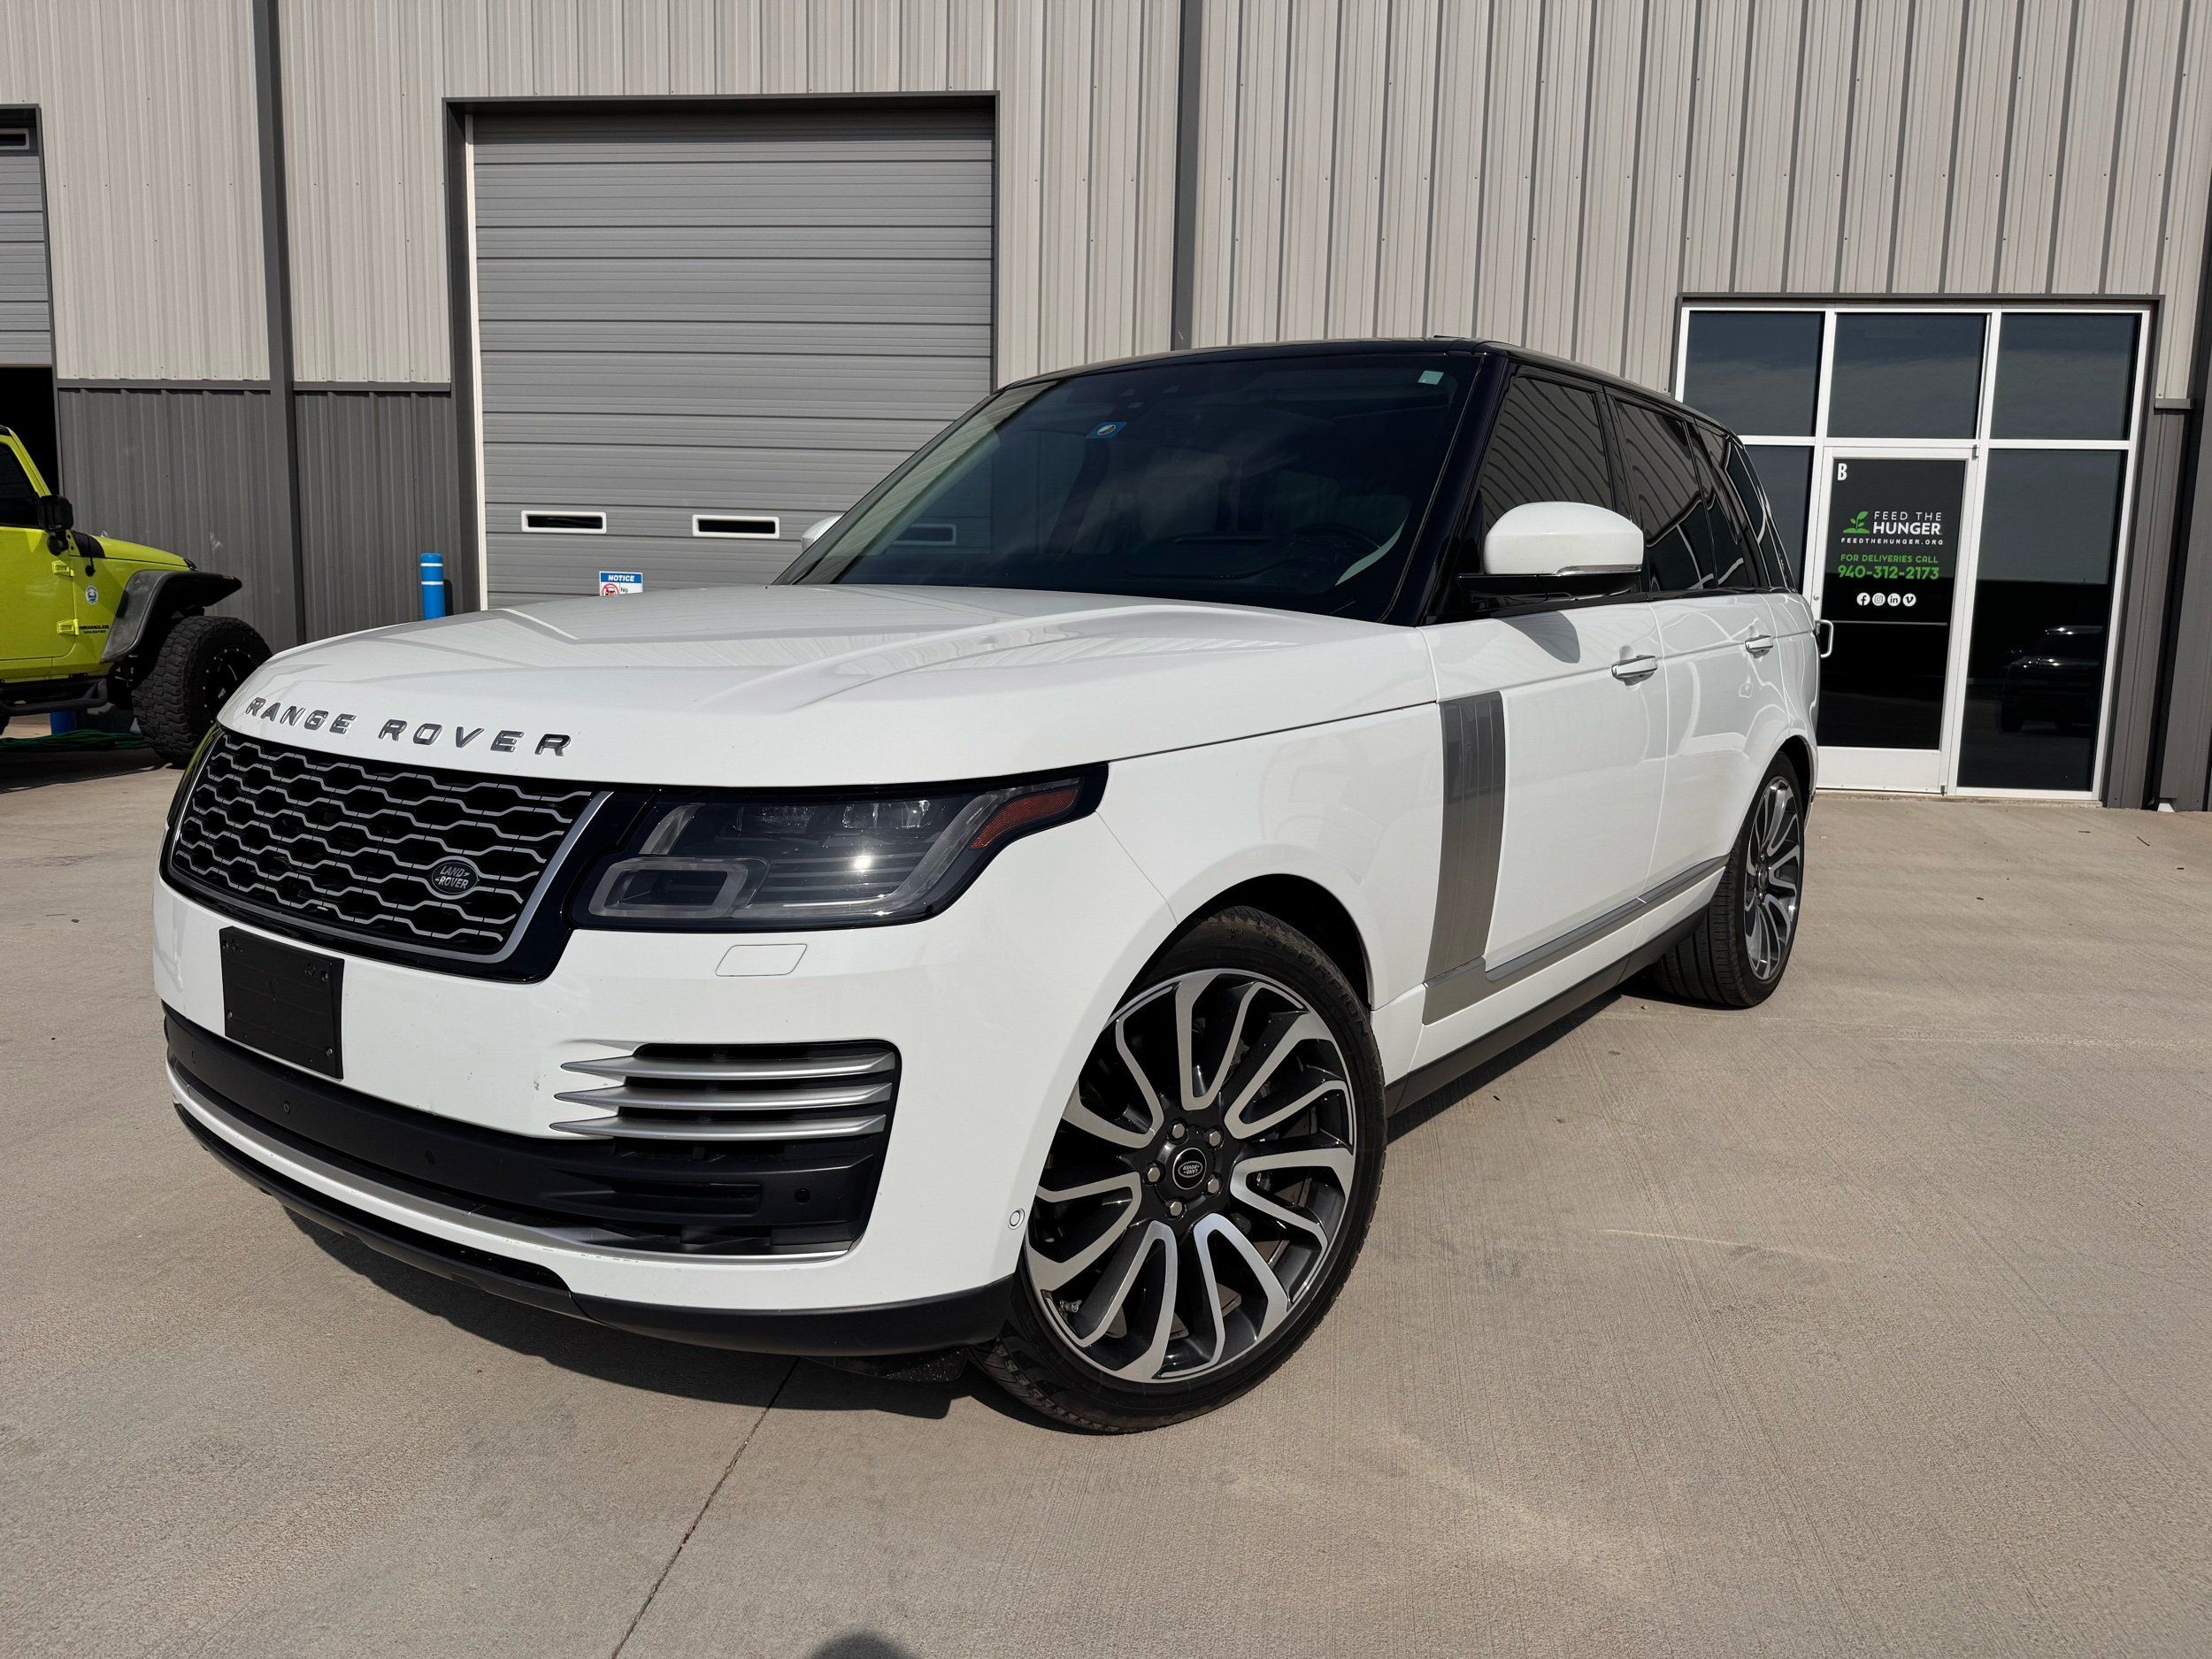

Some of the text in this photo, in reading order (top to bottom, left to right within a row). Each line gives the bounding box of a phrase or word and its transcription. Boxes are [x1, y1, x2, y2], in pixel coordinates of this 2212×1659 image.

[1837, 463, 1847, 480] B
[1873, 511, 1942, 521] FEED THE
[1872, 521, 1941, 535] HUNGER
[1840, 553, 1859, 562] FOR
[1862, 554, 1912, 563] DELIVERIES
[1838, 565, 1939, 580] 940-312-2173
[245, 696, 572, 757] RANGE ROVER
[440, 865, 465, 878] LAND
[438, 875, 469, 889] ROVER
